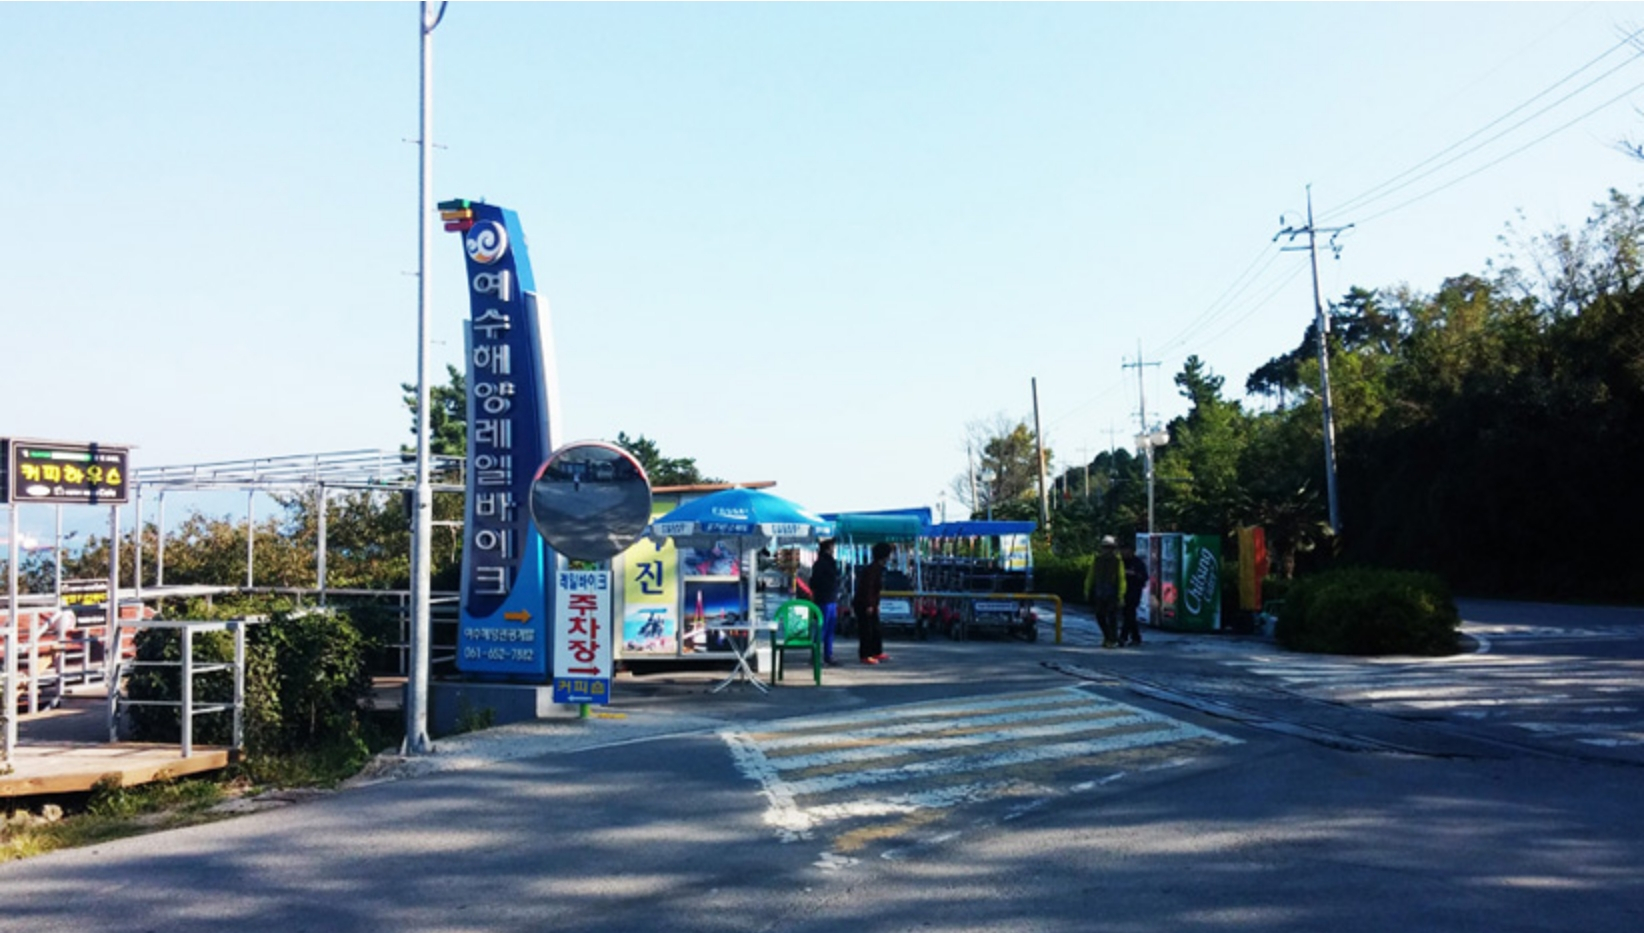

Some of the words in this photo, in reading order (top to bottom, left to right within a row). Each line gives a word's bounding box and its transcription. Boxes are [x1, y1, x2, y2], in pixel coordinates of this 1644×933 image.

[473, 268, 516, 596] 여수해양레일바이크
[20, 463, 123, 486] 커피하우스
[559, 572, 608, 590] 레일바이크
[567, 594, 601, 663] 주차장
